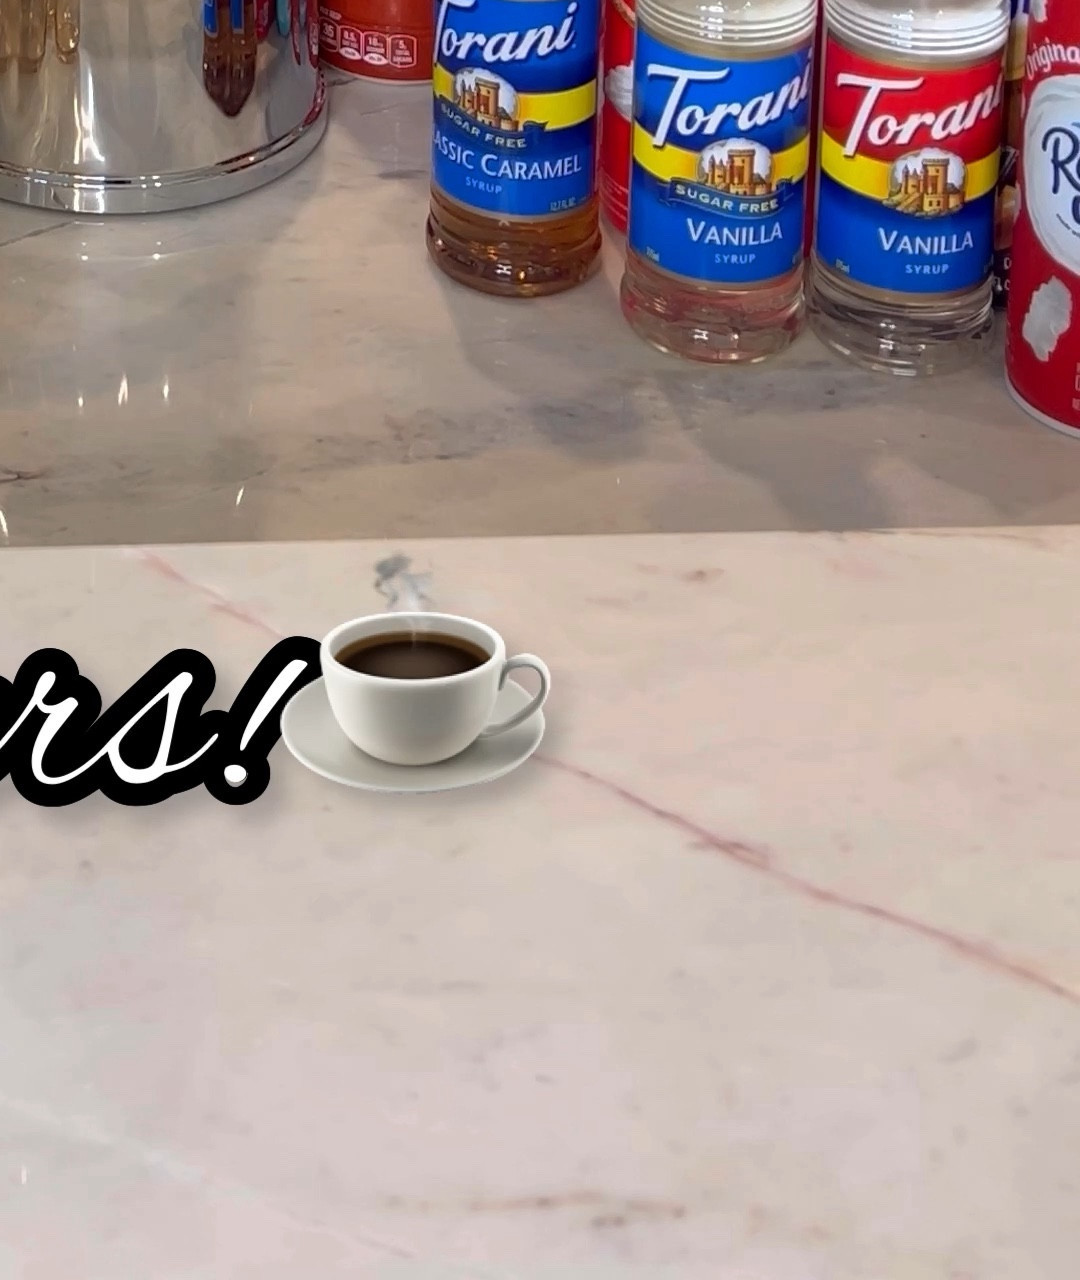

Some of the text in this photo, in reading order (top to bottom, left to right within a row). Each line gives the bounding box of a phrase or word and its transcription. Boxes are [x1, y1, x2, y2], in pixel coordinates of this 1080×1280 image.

[647, 47, 812, 147] Torani
[836, 53, 1006, 157] Torani
[441, 103, 528, 149] SUGAR FREE
[480, 153, 582, 181] CARAMEL
[1042, 126, 1080, 196] R
[465, 175, 503, 194] SYRUP
[675, 184, 779, 213] SUGAR FREE
[686, 217, 783, 246] VANILLA
[878, 226, 974, 255] VANILLA
[714, 253, 757, 265] SYRUP
[904, 263, 950, 275] SYRUP
